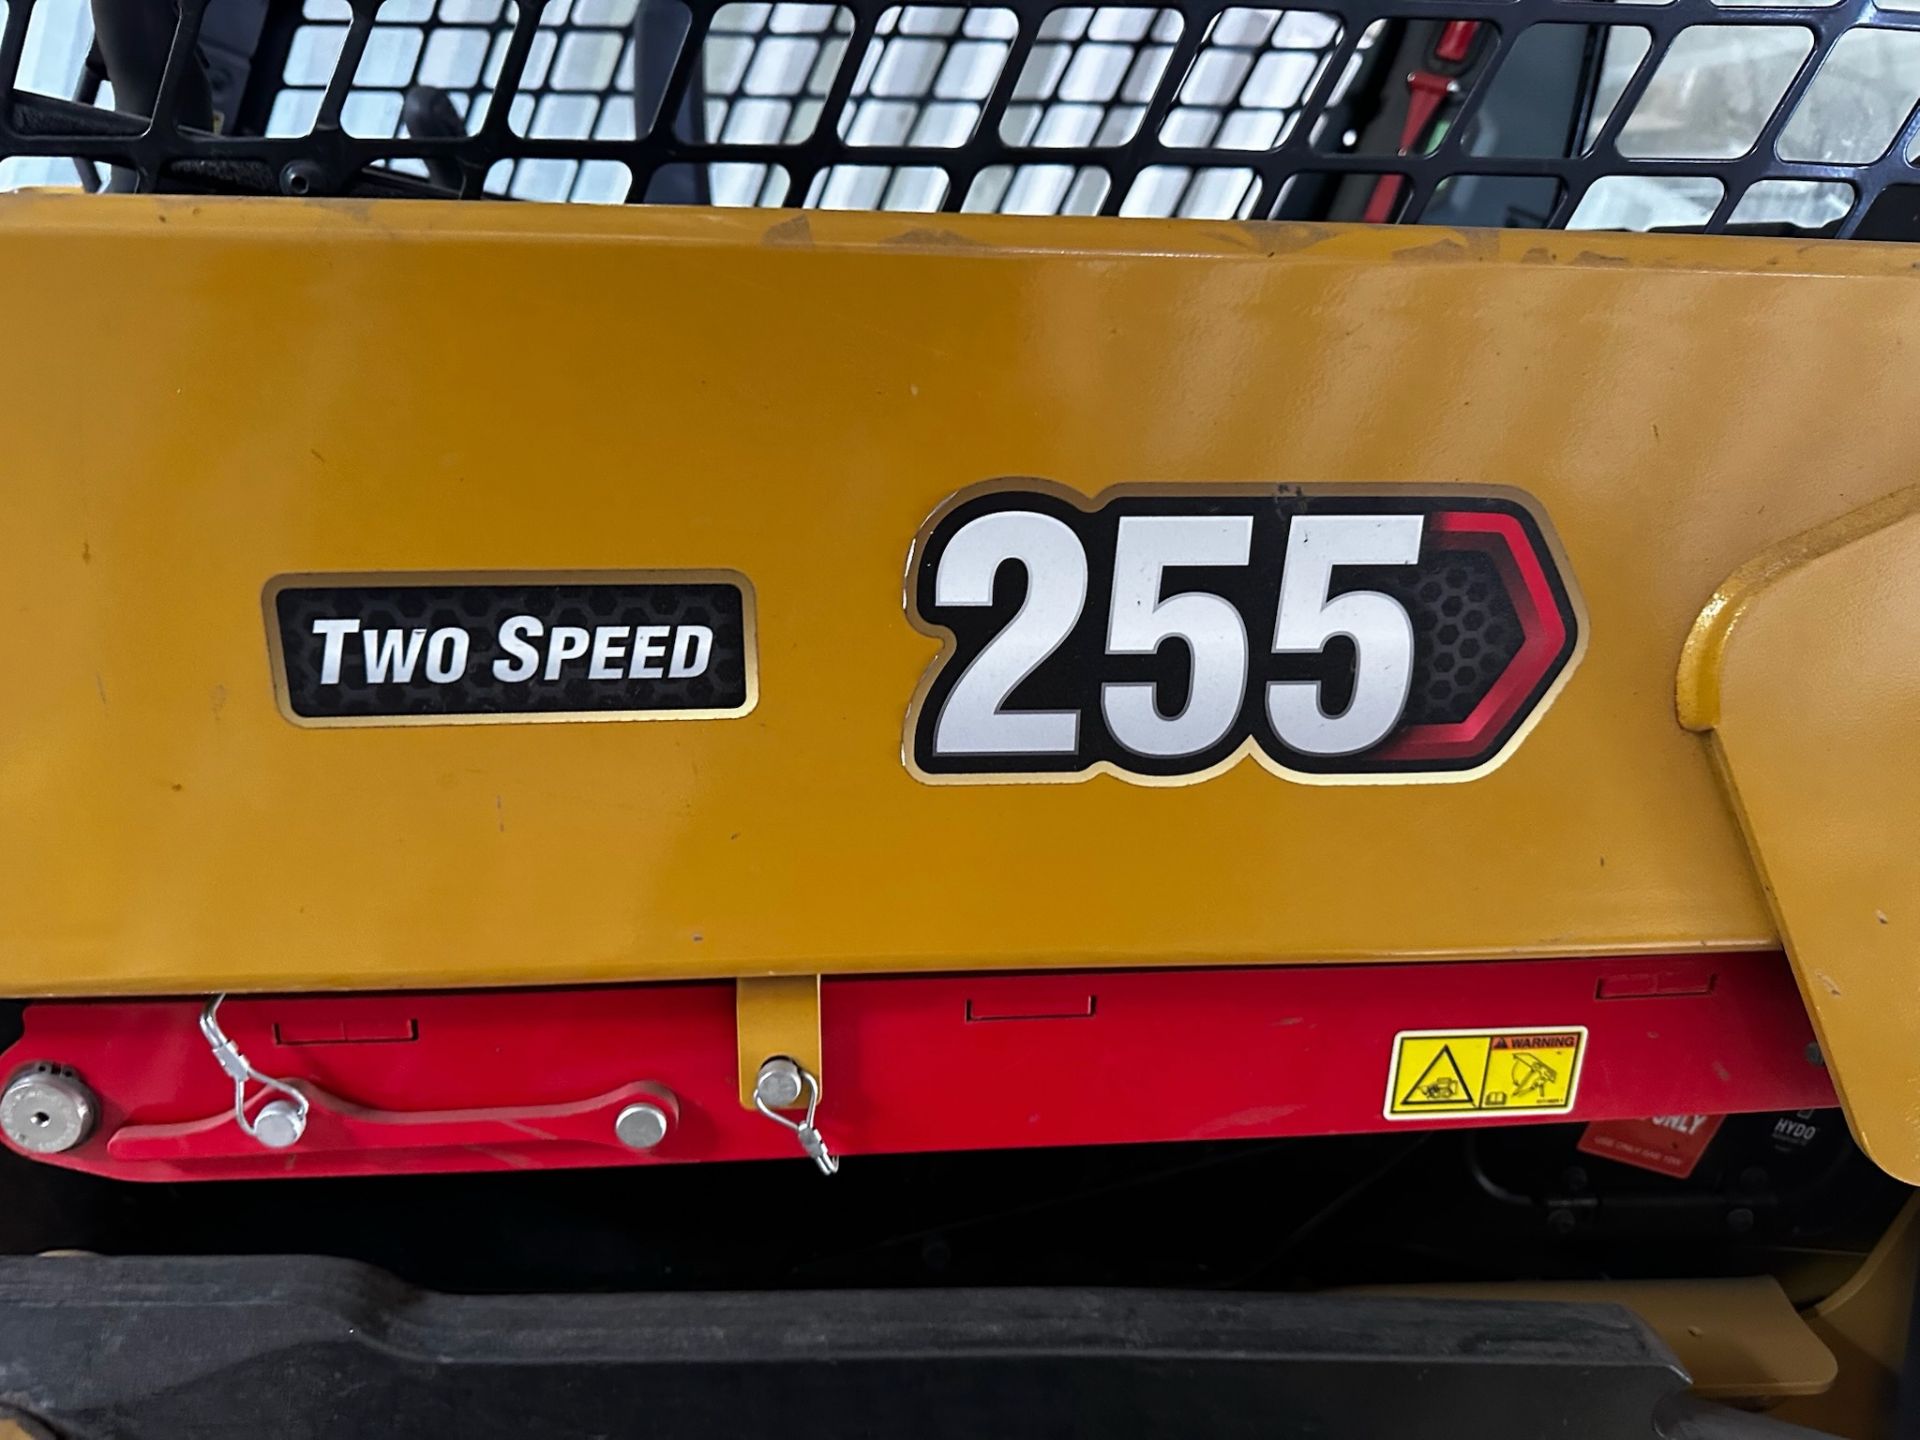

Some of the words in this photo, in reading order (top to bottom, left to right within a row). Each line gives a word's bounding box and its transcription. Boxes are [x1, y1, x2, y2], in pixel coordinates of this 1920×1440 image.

[312, 618, 470, 685] TWO
[492, 615, 714, 684] SPEED
[932, 510, 1425, 758] 255
[1511, 1036, 1575, 1049] WARNING
[1774, 1117, 1816, 1140] HYDO
